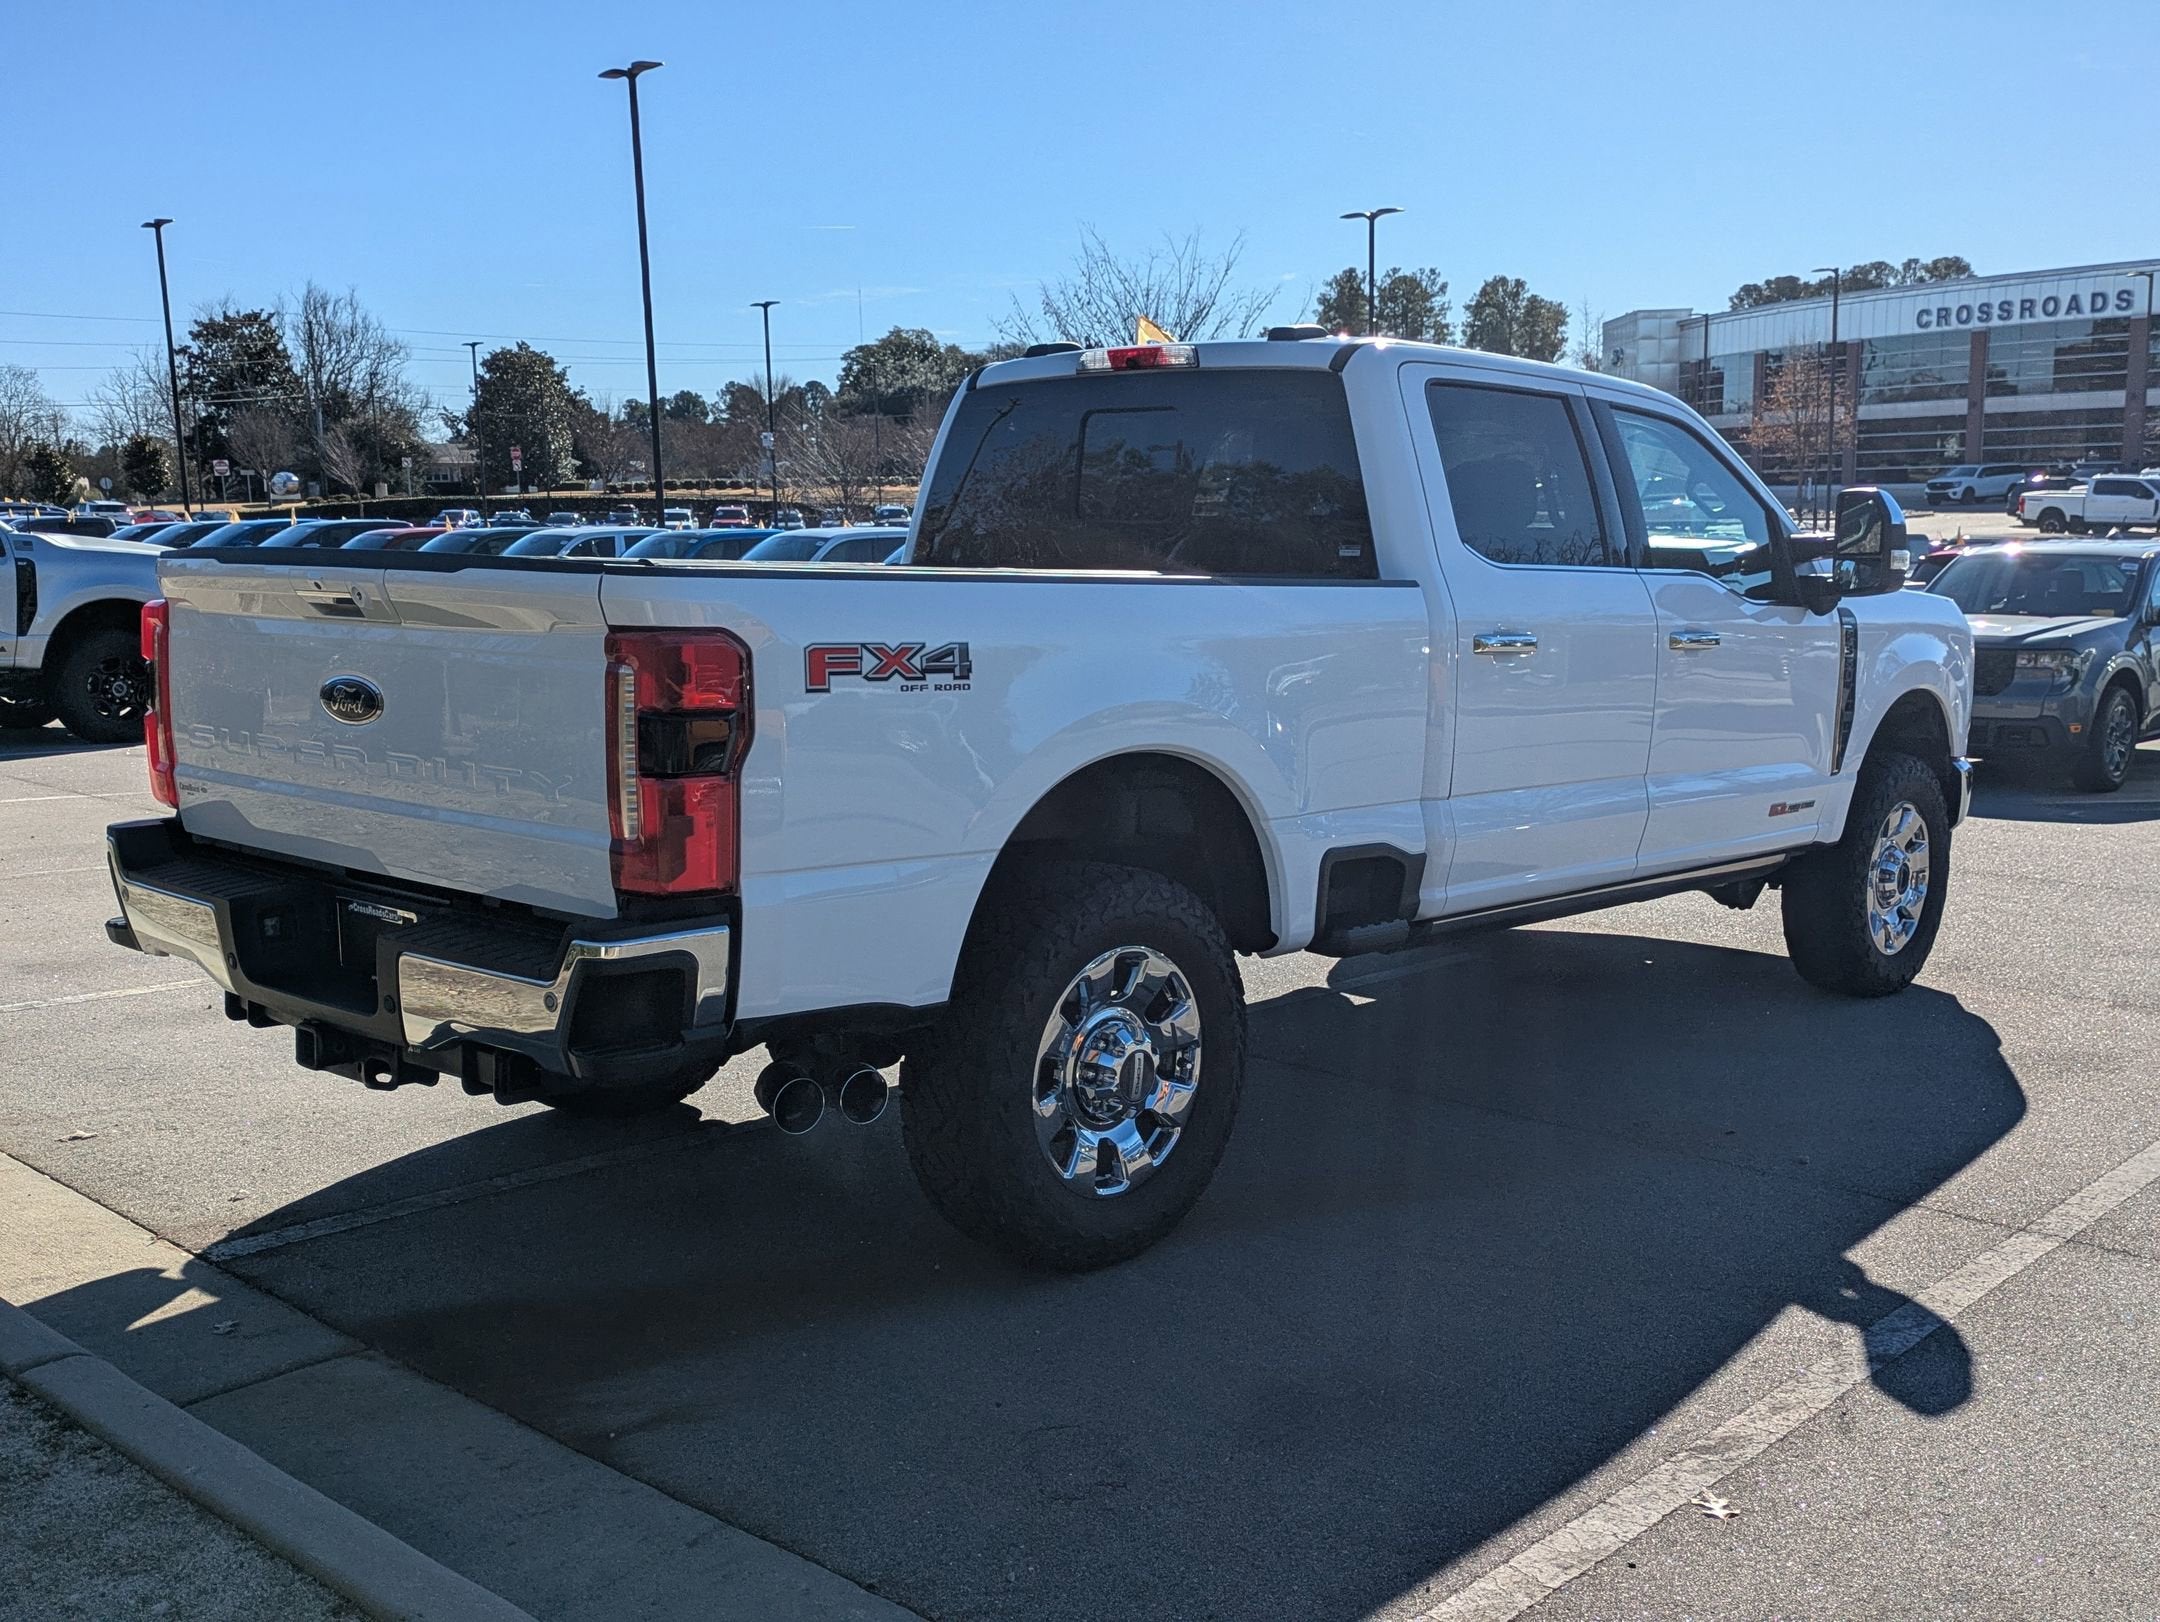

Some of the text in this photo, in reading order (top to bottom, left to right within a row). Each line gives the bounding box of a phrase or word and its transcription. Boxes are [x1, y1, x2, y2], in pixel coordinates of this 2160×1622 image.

[1916, 290, 2135, 329] CROSSROADS
[804, 642, 972, 694] FX4
[330, 685, 365, 714] Ford
[900, 683, 971, 693] OFF ROAD
[188, 722, 573, 801] SUPER DUTY
